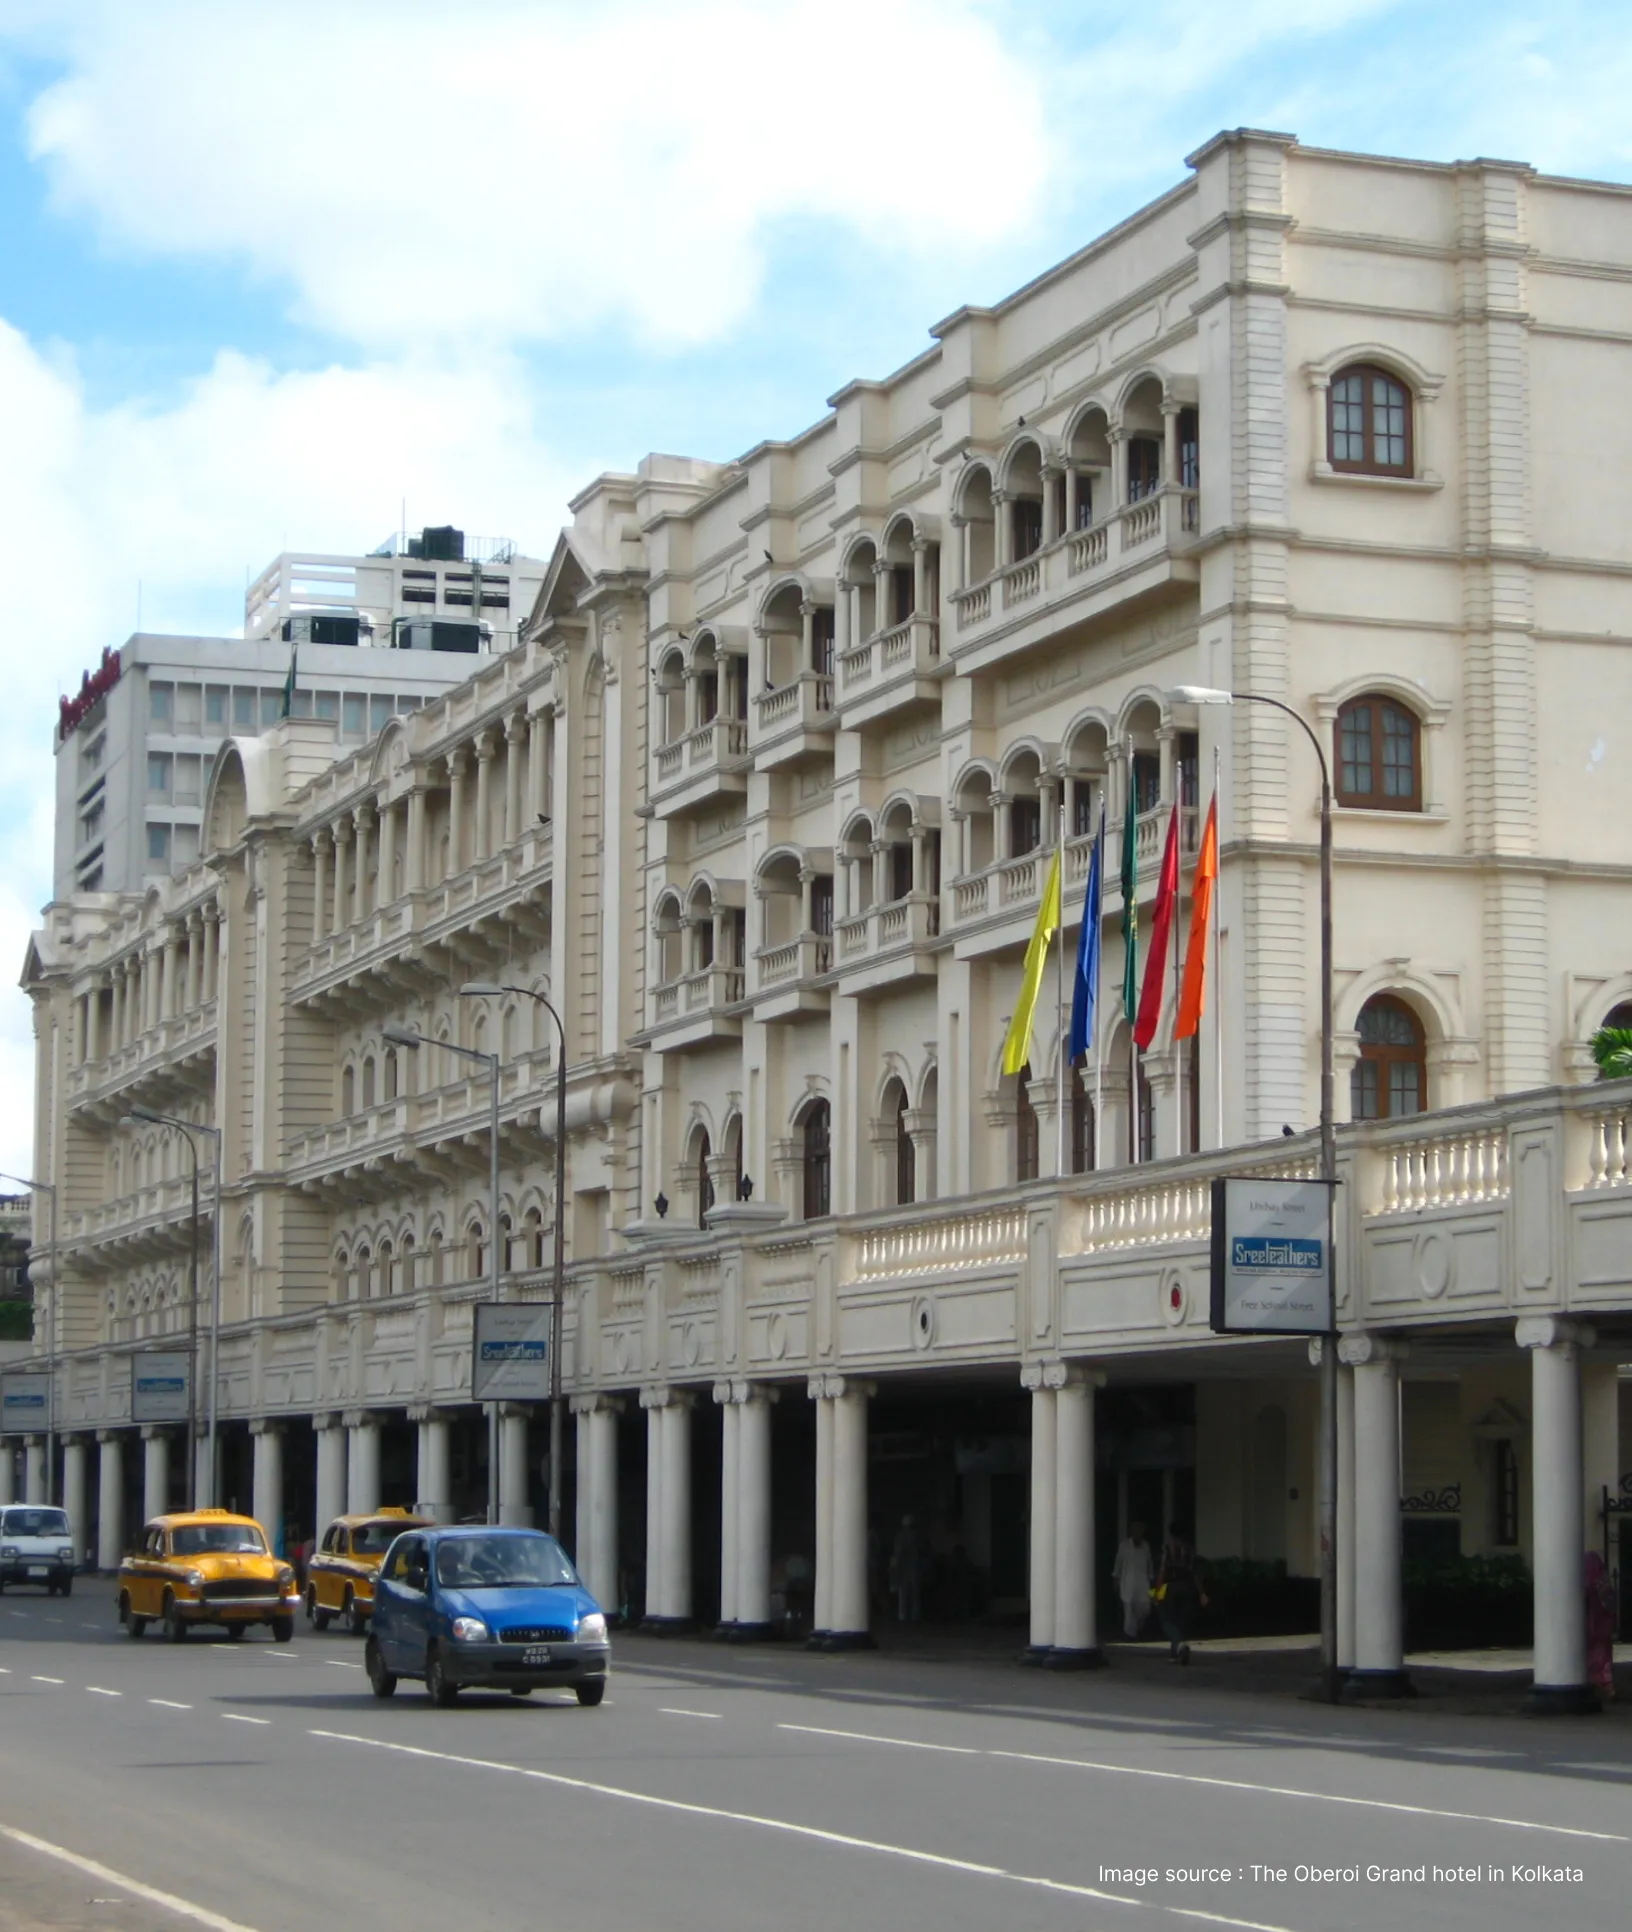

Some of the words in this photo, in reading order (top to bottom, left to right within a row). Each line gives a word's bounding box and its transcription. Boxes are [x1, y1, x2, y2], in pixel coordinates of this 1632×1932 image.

[1282, 1202, 1306, 1213] Street
[1235, 1240, 1319, 1266] Sreeleathers
[1241, 1300, 1258, 1310] Free
[1290, 1301, 1317, 1312] Street
